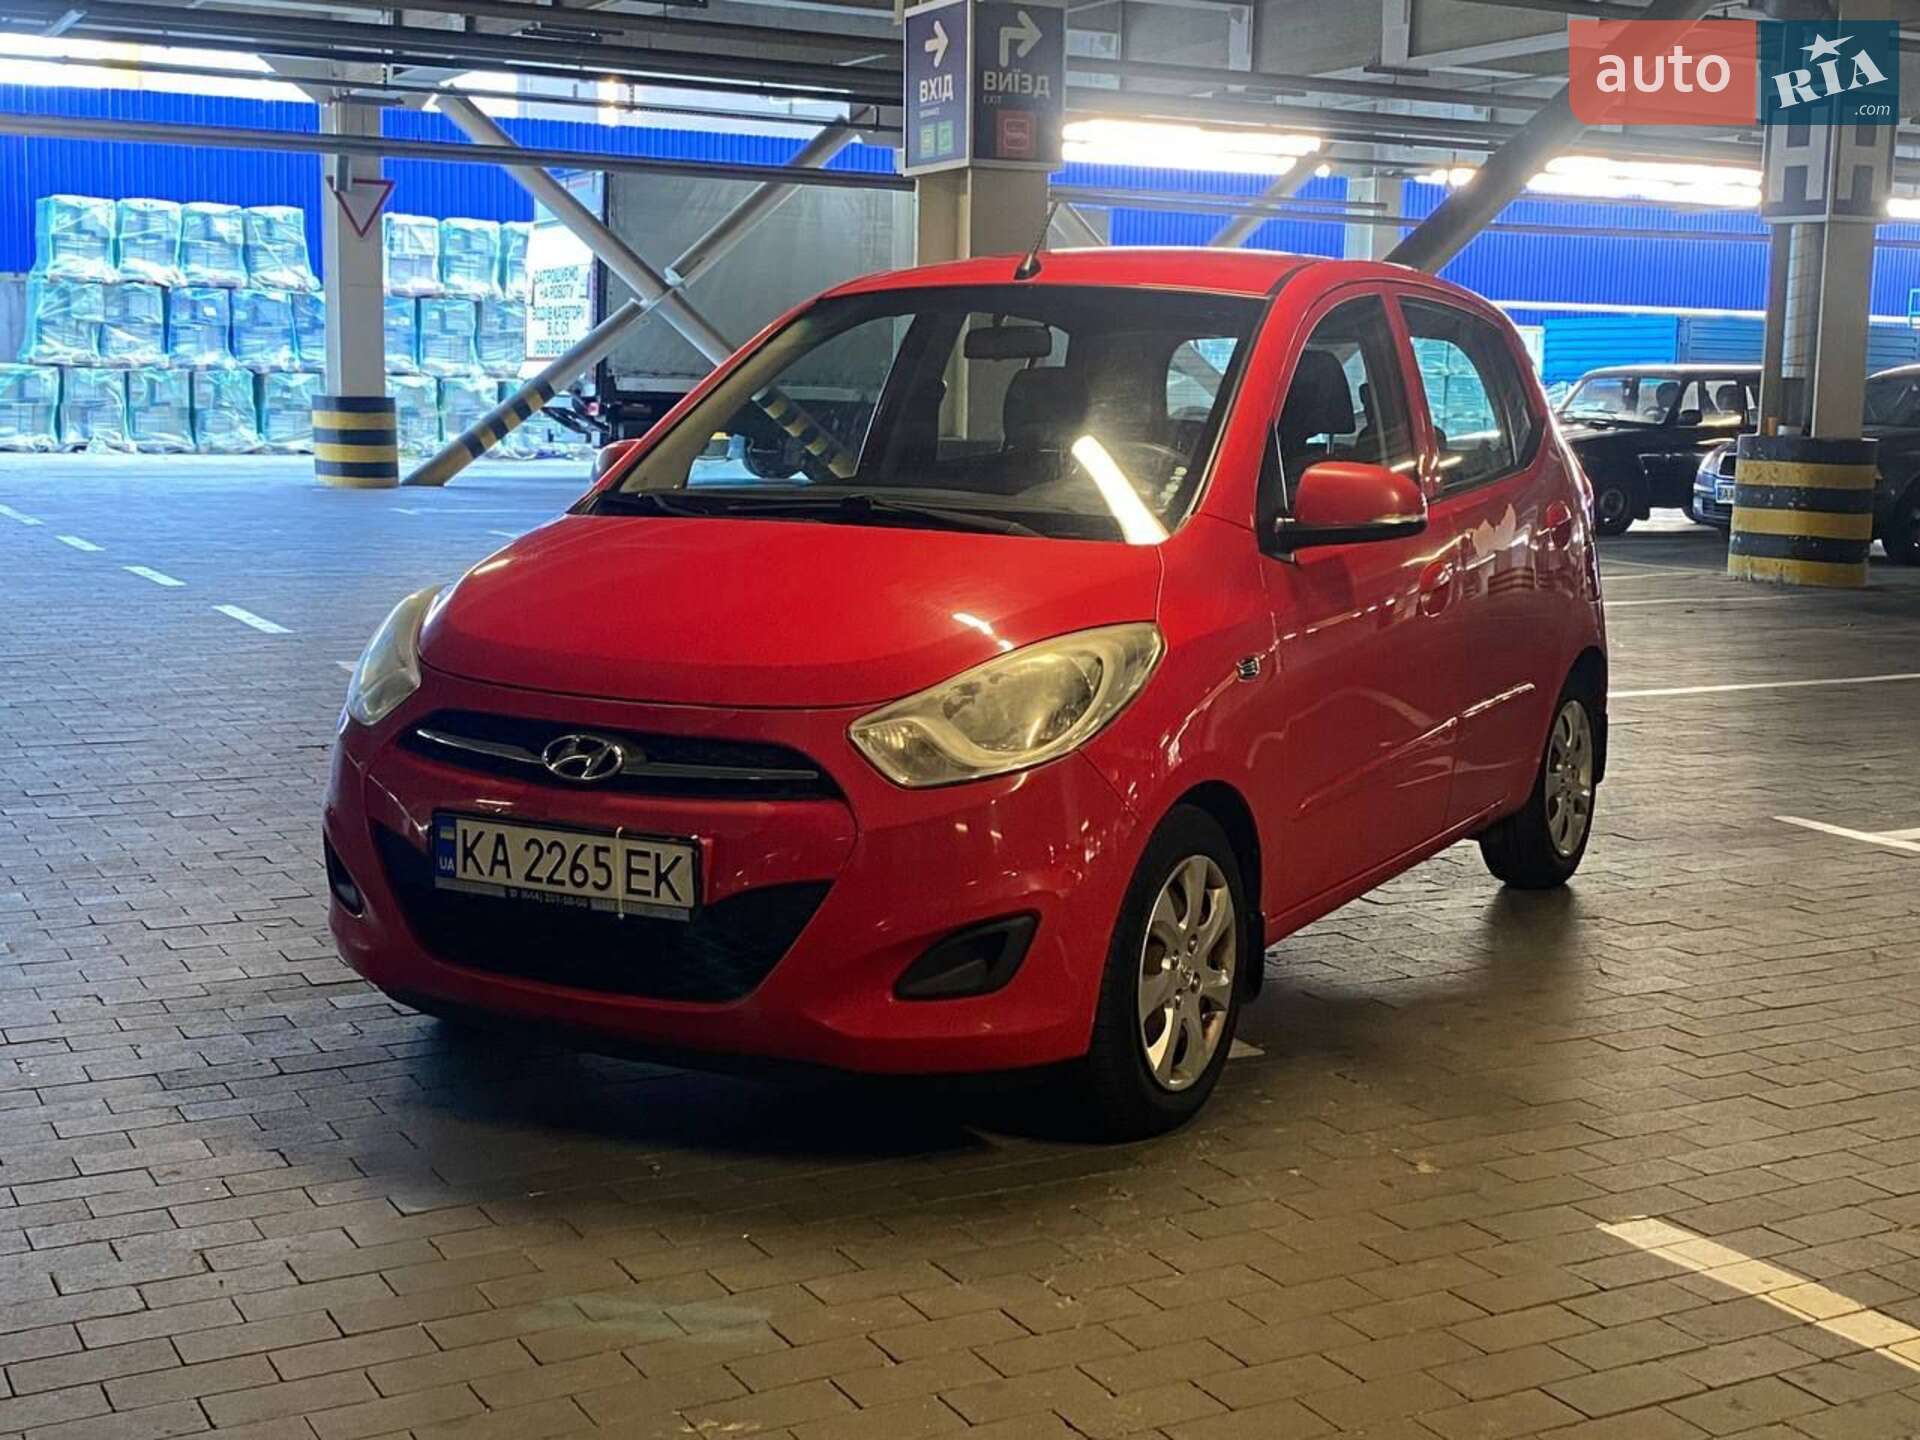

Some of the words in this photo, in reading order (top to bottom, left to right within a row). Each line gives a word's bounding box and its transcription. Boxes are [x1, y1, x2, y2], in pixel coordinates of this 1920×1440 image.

[919, 74, 954, 103] ВХІД
[983, 68, 1050, 99] ВИЇЗД
[438, 855, 456, 872] UA
[461, 829, 512, 879] KA
[524, 838, 612, 891] 2265
[625, 848, 683, 901] EK
